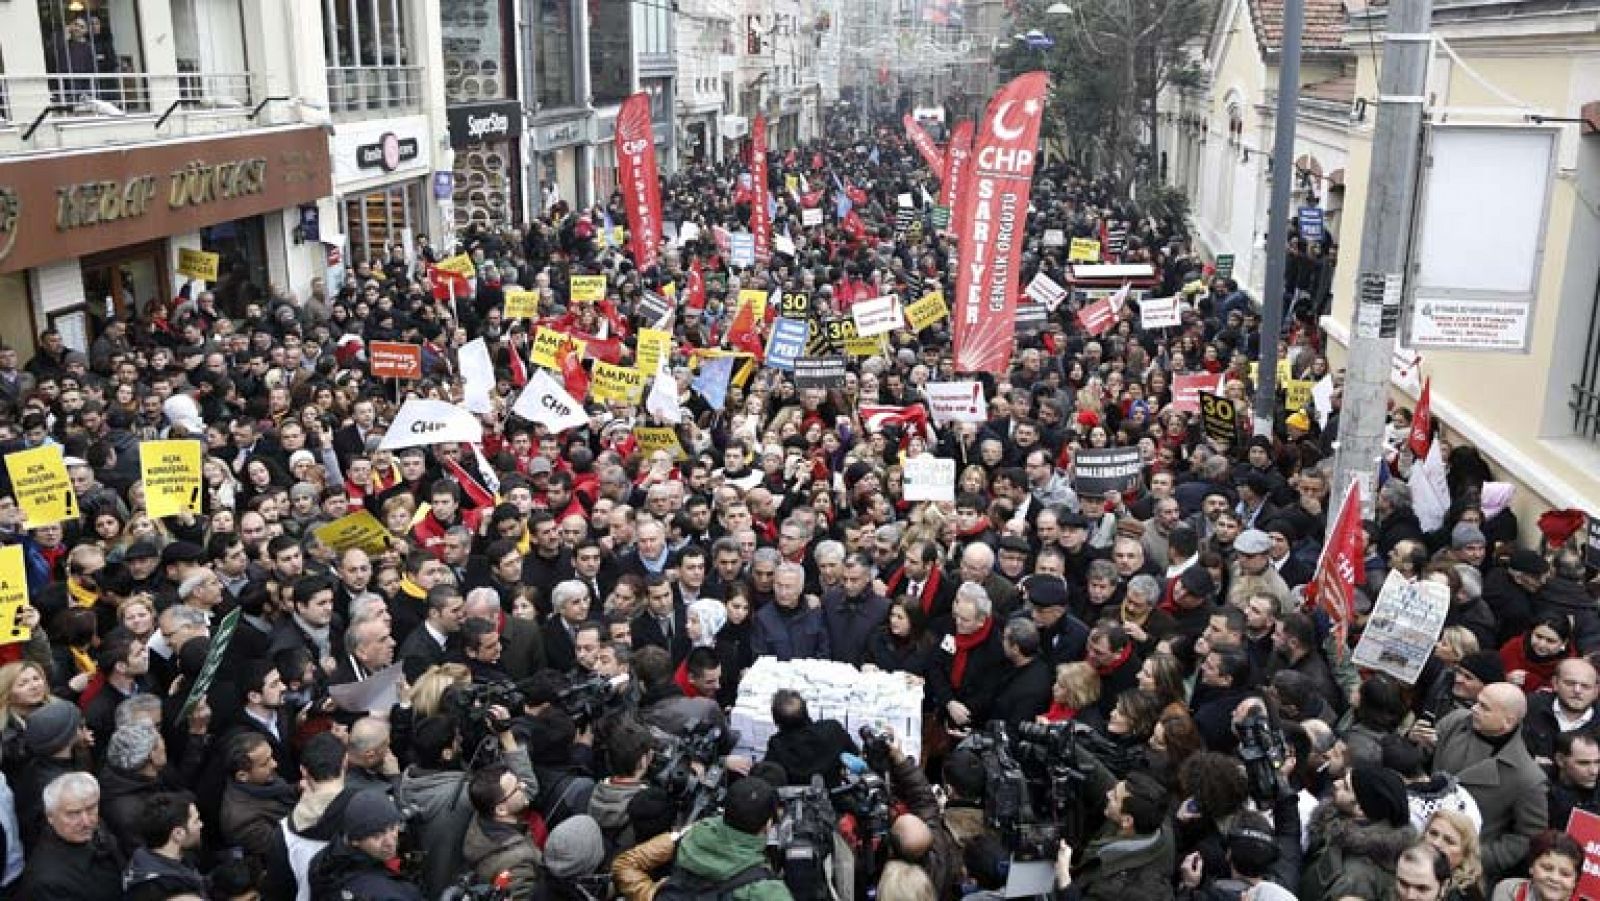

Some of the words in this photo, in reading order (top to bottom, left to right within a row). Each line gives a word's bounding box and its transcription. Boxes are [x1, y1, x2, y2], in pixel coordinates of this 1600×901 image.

[978, 145, 1032, 172] CHP
[966, 179, 993, 324] SARIYER
[783, 293, 806, 310] 30
[596, 368, 640, 385] AMPUL
[541, 395, 571, 416] CHP
[1202, 396, 1232, 419] 30
